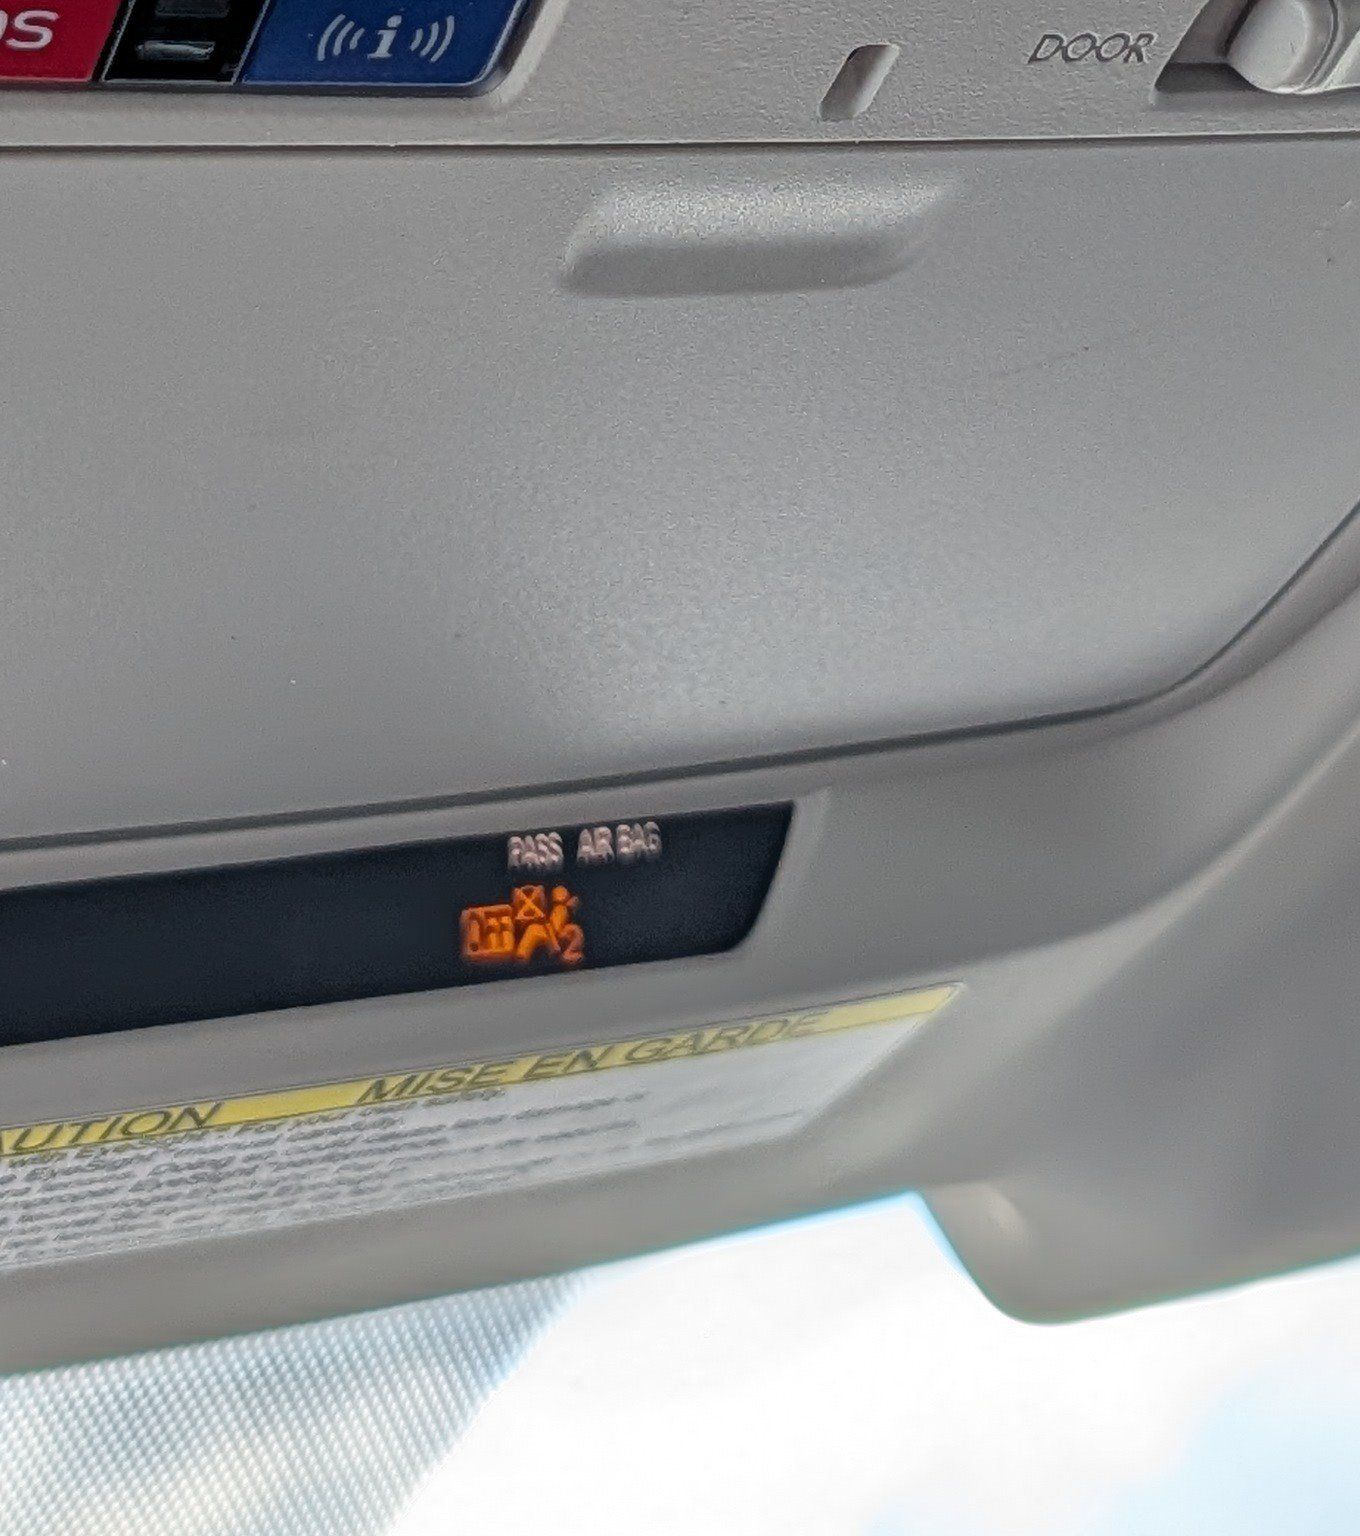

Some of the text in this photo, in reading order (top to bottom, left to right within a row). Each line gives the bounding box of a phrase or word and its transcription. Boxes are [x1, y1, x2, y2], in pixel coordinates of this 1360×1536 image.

[1027, 33, 1157, 65] DOOR
[355, 1011, 829, 1104] MISE EN GARDE
